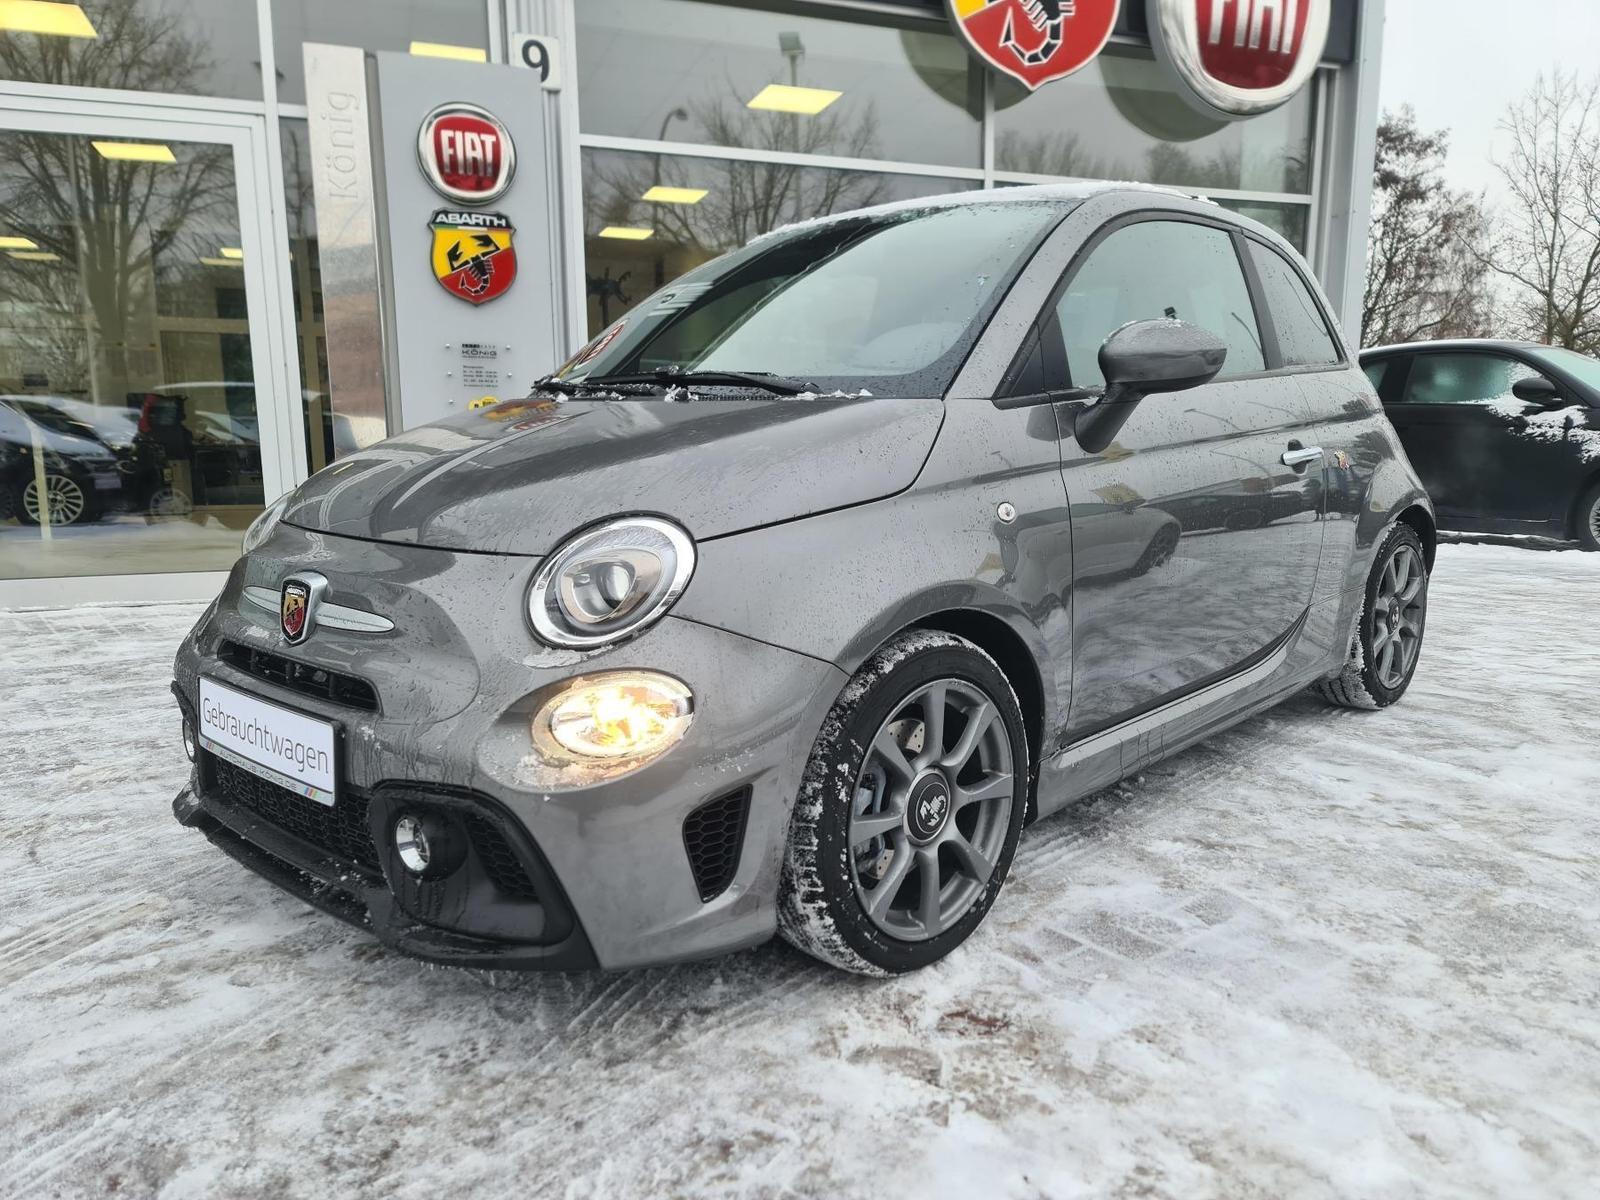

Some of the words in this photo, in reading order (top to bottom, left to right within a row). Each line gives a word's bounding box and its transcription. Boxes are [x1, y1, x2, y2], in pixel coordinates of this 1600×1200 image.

[521, 39, 550, 83] 9
[321, 91, 359, 199] König
[440, 129, 497, 177] FIAT
[435, 213, 507, 227] ABARTH
[202, 697, 329, 774] Gebrauchtwagen
